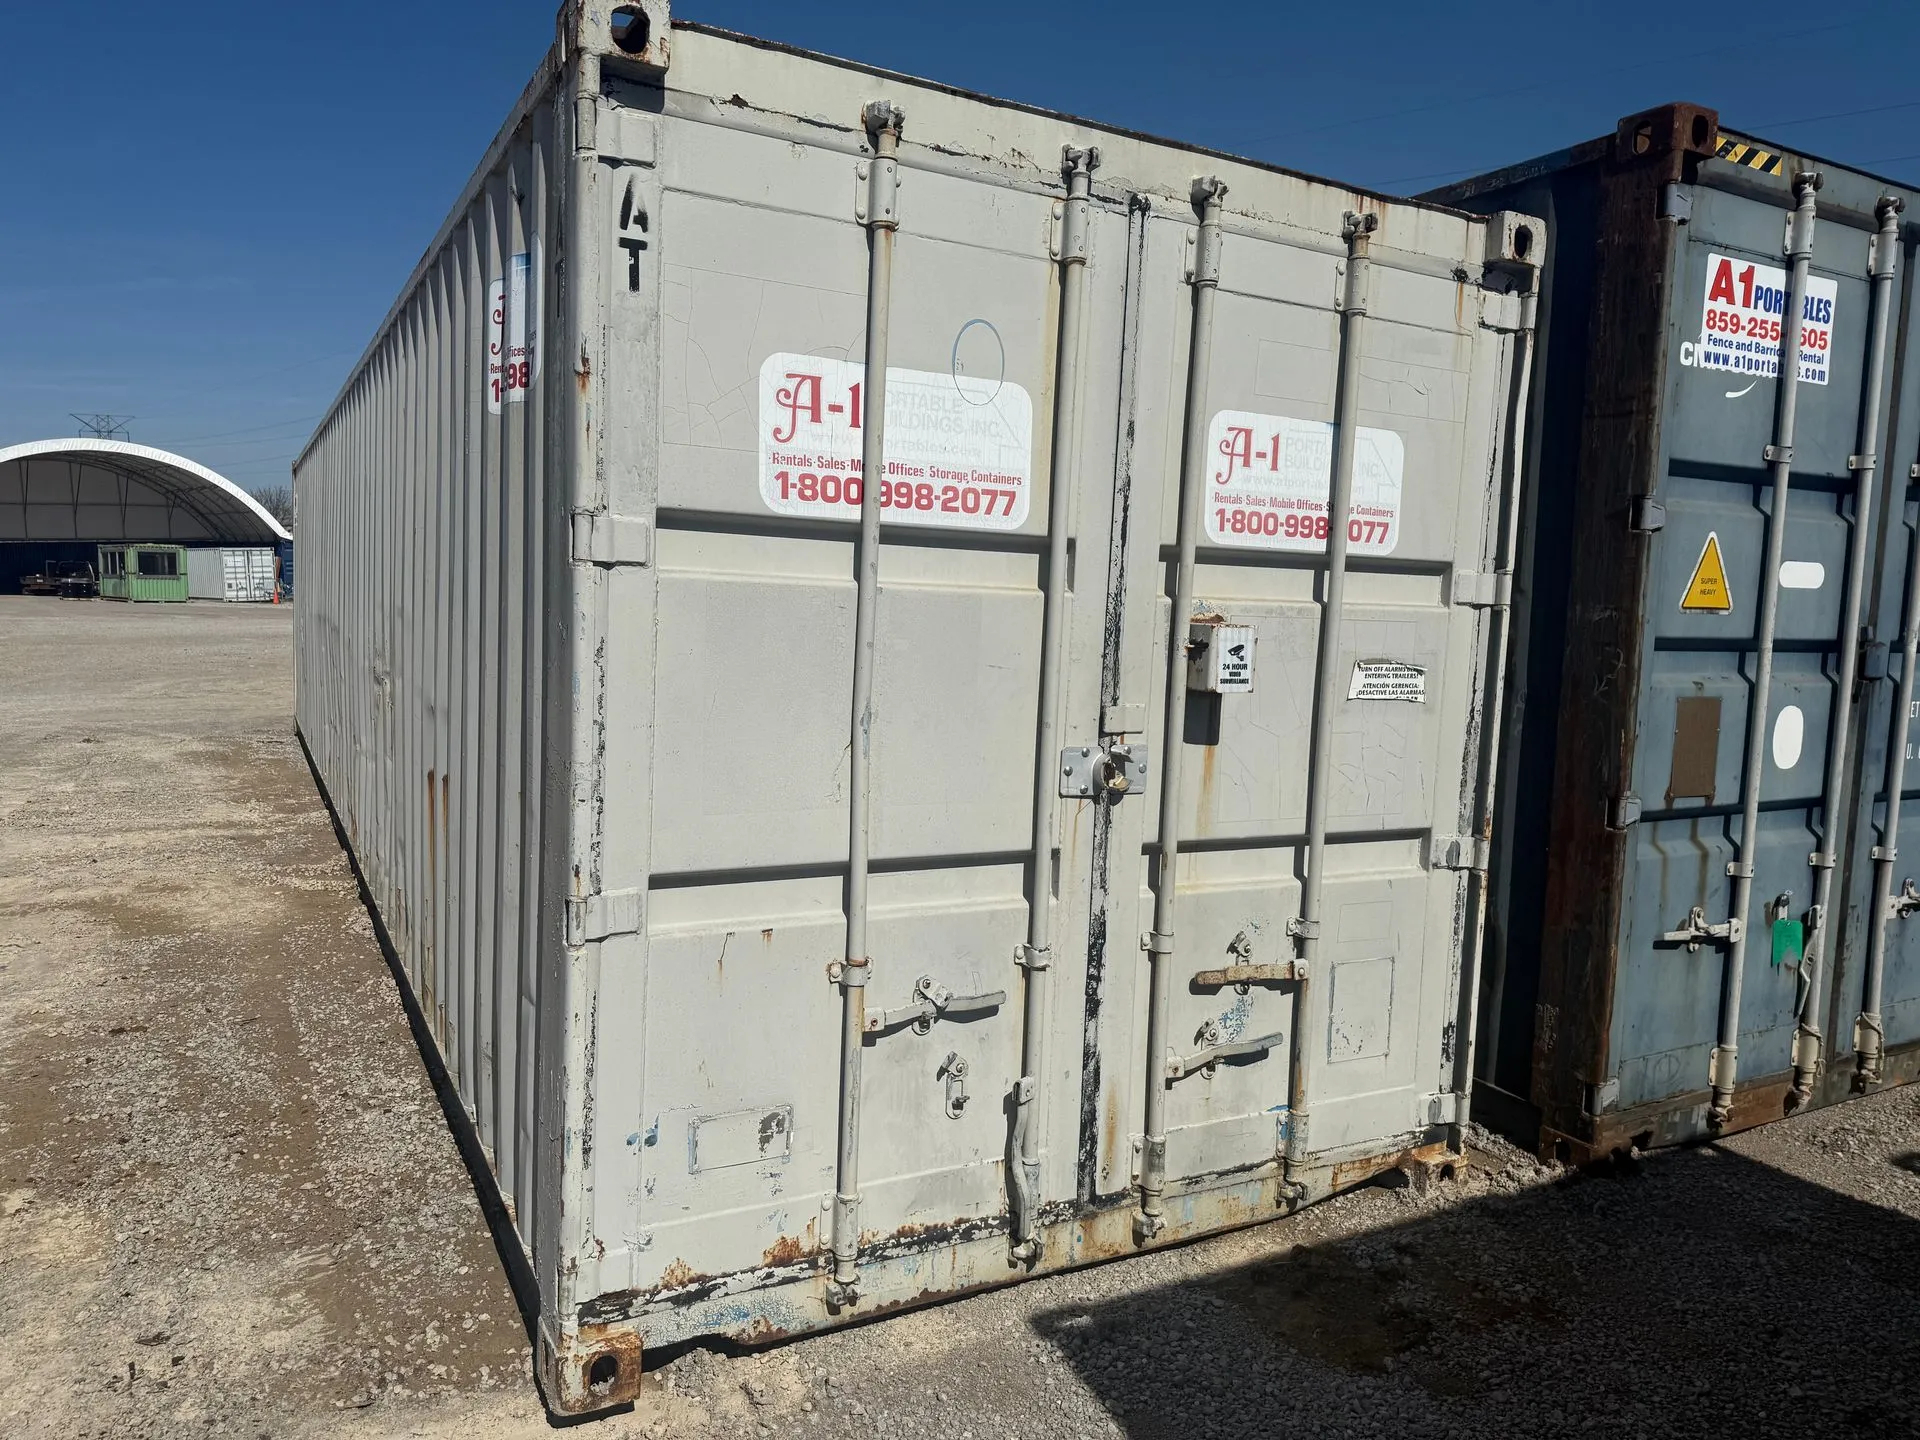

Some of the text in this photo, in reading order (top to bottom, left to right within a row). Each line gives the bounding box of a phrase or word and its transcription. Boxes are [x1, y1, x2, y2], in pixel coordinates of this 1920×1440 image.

[1708, 258, 1832, 325] A1 PORTBLES
[1705, 308, 1829, 351] 859-255-605
[1707, 334, 1734, 350] Fence
[1735, 340, 1753, 353] and
[772, 372, 862, 444] A-1
[772, 452, 813, 468] Rentals
[817, 455, 846, 471] Sales
[889, 461, 925, 477] Offices
[929, 466, 969, 483] Storage
[971, 470, 1023, 486] Containers
[1215, 426, 1281, 485] A-1
[774, 471, 1017, 517] 1-800998-2077
[1214, 492, 1243, 505] Rentals
[1245, 495, 1267, 507] Sales
[1269, 496, 1296, 509] Mobile
[1296, 499, 1323, 512] Offices
[1356, 504, 1395, 518] Containers
[1215, 508, 1390, 545] 1-800-998-077
[1699, 588, 1717, 596] HEAVY
[1700, 577, 1718, 585] SUPER
[1222, 663, 1248, 671] 24 HOUR
[1361, 681, 1390, 689] ATENCIÓN
